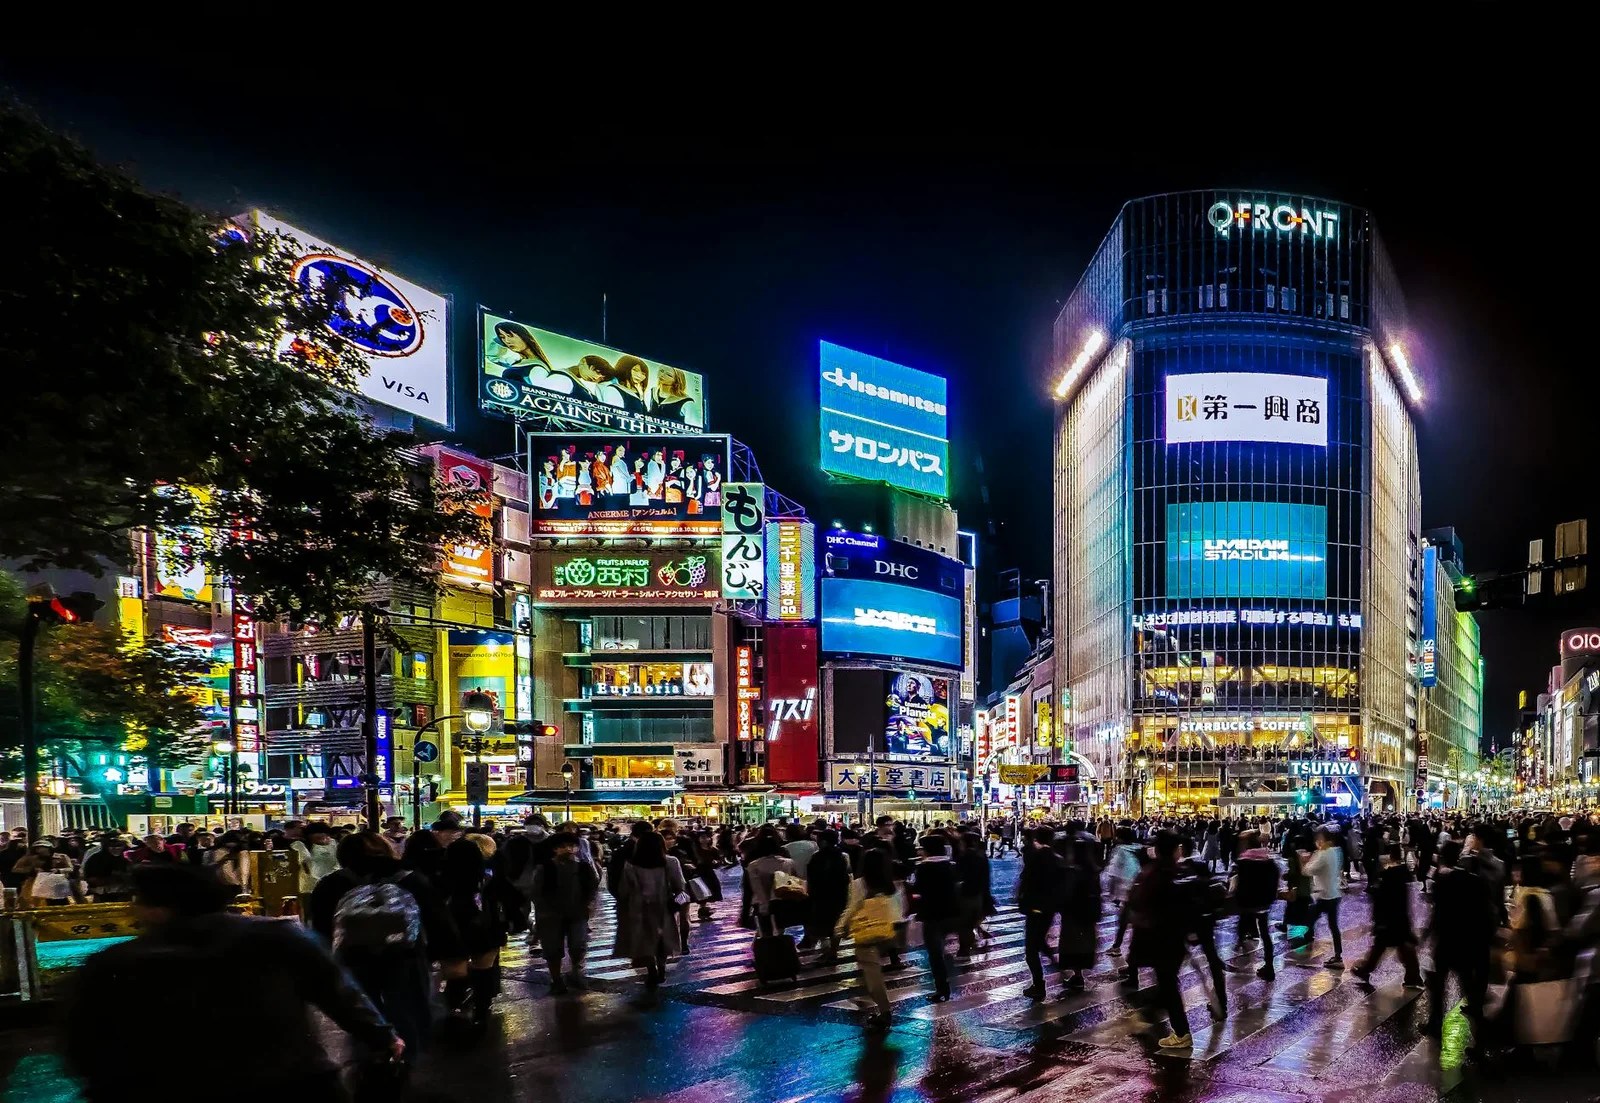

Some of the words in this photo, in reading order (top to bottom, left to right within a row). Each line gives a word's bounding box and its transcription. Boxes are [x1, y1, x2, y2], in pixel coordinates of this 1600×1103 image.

[381, 375, 431, 404] VISA
[521, 385, 547, 397] BRAND
[547, 391, 566, 401] NEW
[583, 400, 612, 412] SOCIETY
[822, 367, 947, 416] Hisamitsu
[1203, 394, 1320, 425] 第一興商
[828, 429, 944, 477] サロンパス
[588, 511, 629, 519] ANGERME
[725, 485, 763, 597] もんじゃ
[826, 536, 845, 545] DHC
[845, 538, 879, 548] Channel
[1204, 550, 1289, 561] STADIUM
[597, 566, 649, 587] 西村
[780, 525, 797, 615] 三千里薬品
[874, 560, 919, 580] DHC
[1423, 639, 1436, 678] SEIBU
[596, 682, 680, 697] Euphoria
[900, 705, 936, 719] Planets
[1180, 721, 1255, 732] STARBUCKS
[1259, 721, 1307, 731] COFFEE
[1291, 761, 1359, 776] TSUTAYA
